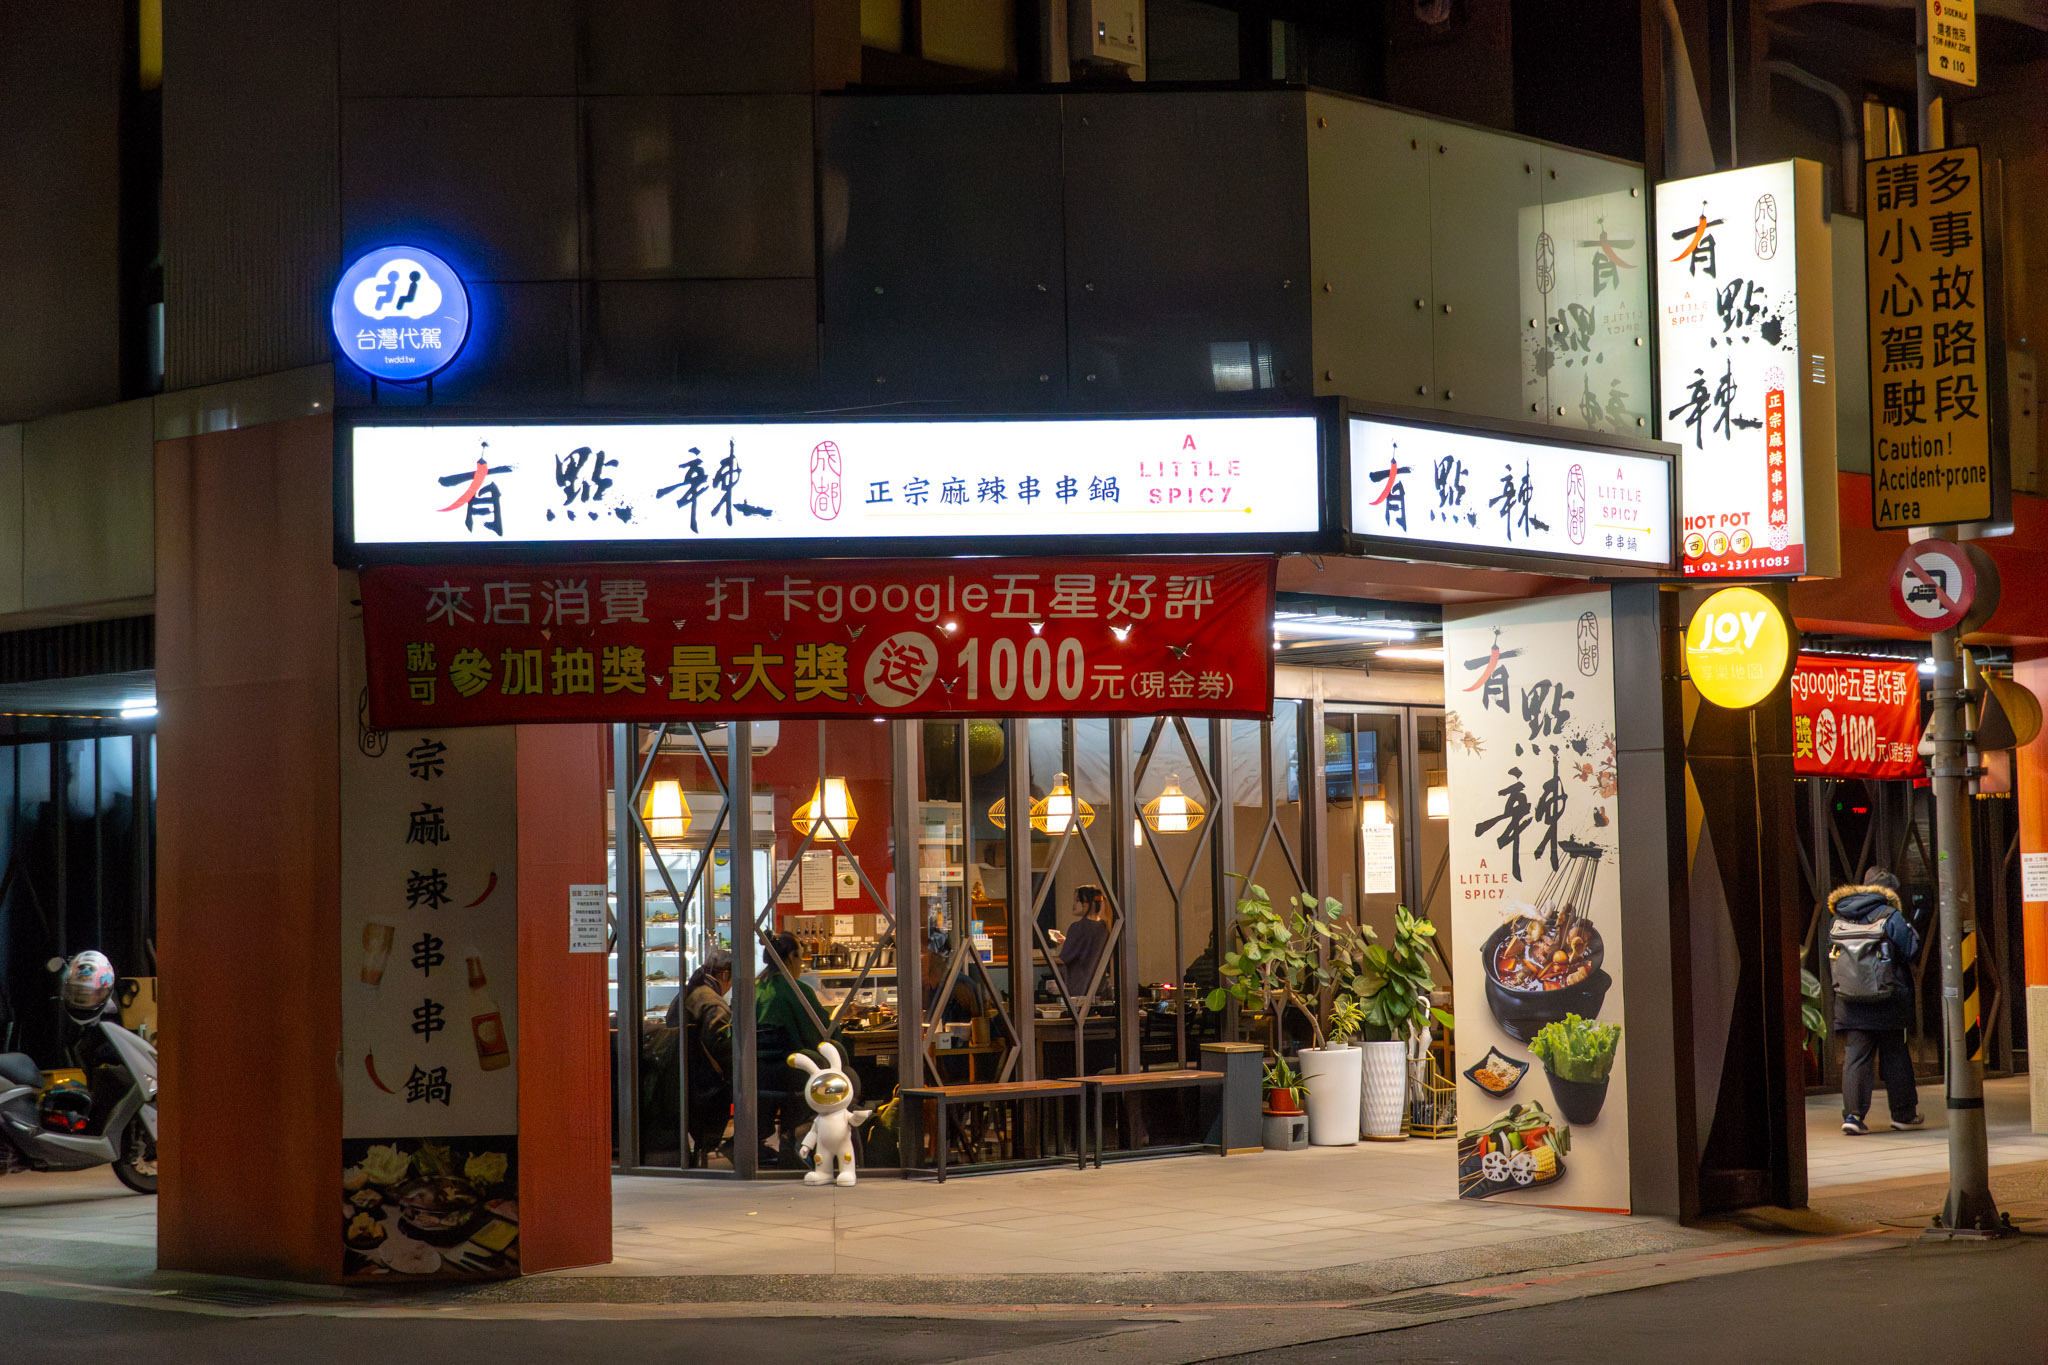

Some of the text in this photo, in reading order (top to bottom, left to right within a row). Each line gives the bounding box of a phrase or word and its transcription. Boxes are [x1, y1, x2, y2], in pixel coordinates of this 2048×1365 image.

[1953, 60, 1965, 73] 110
[1684, 291, 1691, 299] A
[1876, 163, 1927, 427] 請小心駕駛
[1927, 156, 1979, 423] 多事故路段
[1668, 302, 1708, 314] LITTLE
[1672, 314, 1704, 326] SPICY
[356, 328, 442, 350] 台灣代駕
[384, 356, 416, 364] twdd.tw
[1182, 435, 1196, 450] A
[1878, 432, 1952, 462] Caution!
[1768, 395, 1786, 523] 正宗麻辣串串鍋
[1139, 460, 1241, 478] LITTLE
[1616, 468, 1624, 481] A
[1878, 464, 1986, 492] Accident-prone
[436, 437, 778, 537] 有點辣
[865, 475, 1121, 505] 正宗麻辣串串鍋
[1149, 486, 1232, 504] SPICY
[1369, 439, 1550, 542] 有點辣
[1599, 486, 1641, 503] LITTLE
[1602, 506, 1638, 522] SPICY
[1879, 498, 1920, 522] Area
[1685, 512, 1750, 530] HOT POT
[1605, 533, 1637, 552] 串串鍋
[425, 573, 1215, 626] 來店消費 打卡google五星好評
[1700, 611, 1767, 650] JOY
[406, 642, 437, 705] 就可
[449, 646, 647, 697] 參加抽獎
[667, 642, 849, 702] 最大獎
[872, 638, 929, 697] 送
[1795, 715, 1814, 759] 獎
[1817, 713, 1834, 757] 送
[1479, 858, 1487, 869] A
[1460, 873, 1508, 885] LITTLE
[1465, 889, 1505, 900] SPICY
[404, 738, 453, 1107] 宗麻辣串串鍋
